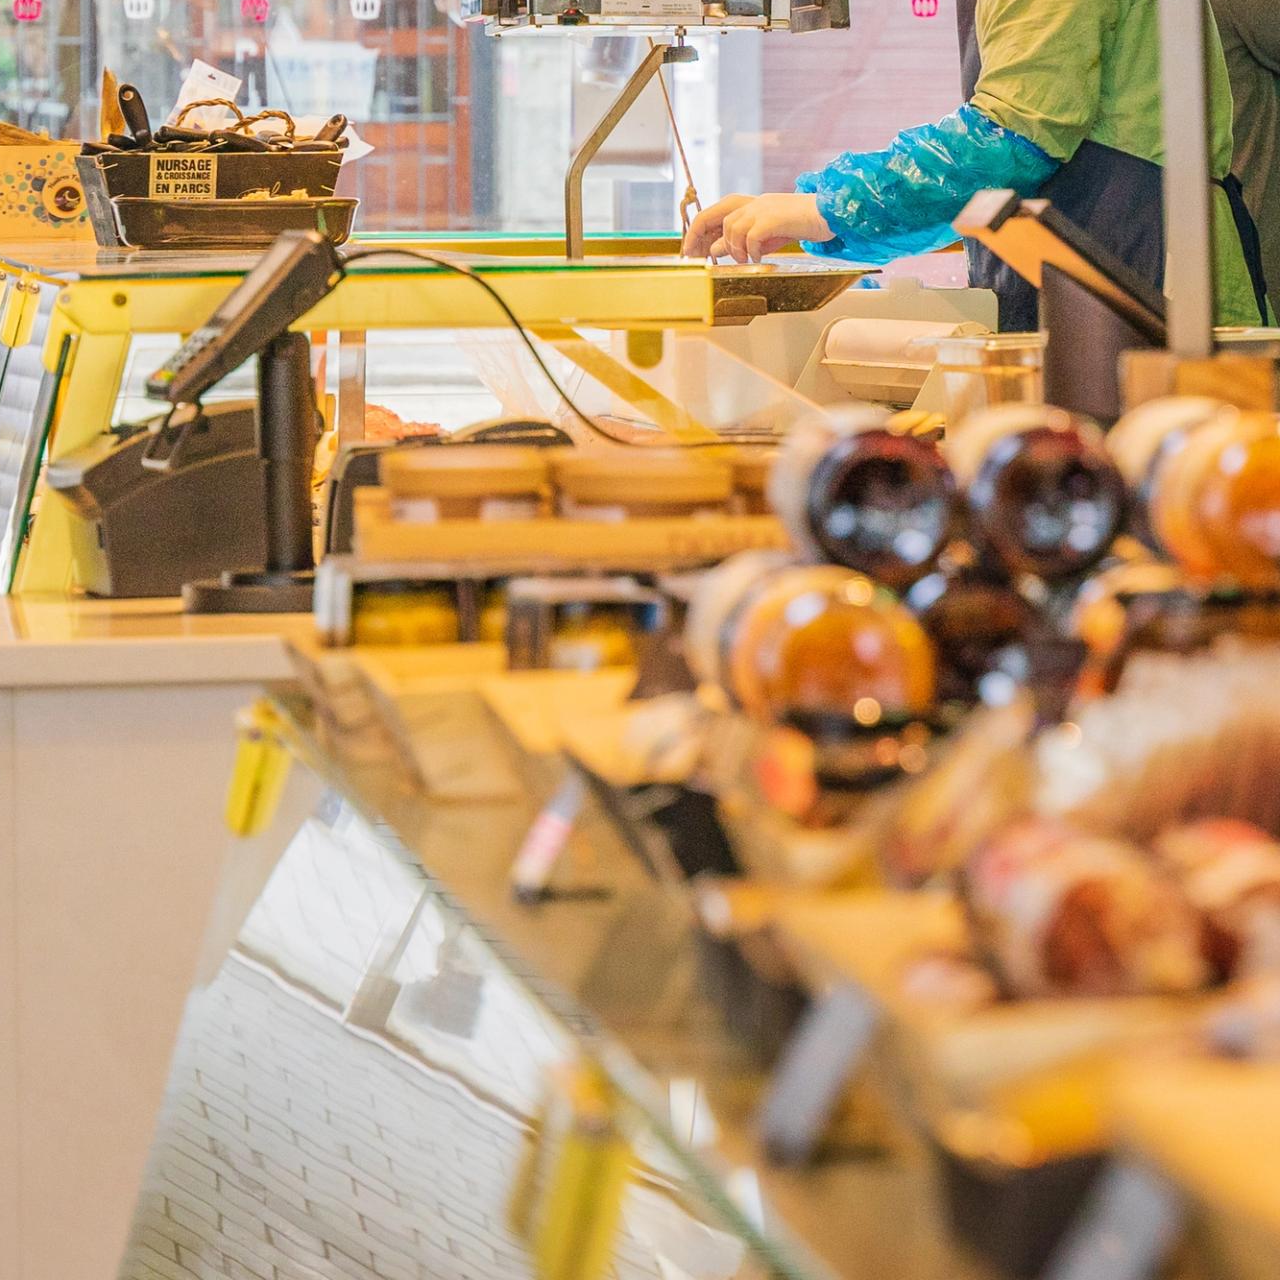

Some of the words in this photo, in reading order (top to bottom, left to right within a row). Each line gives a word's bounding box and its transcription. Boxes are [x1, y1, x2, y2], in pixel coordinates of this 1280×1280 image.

[156, 159, 212, 171] NURSAGE
[156, 172, 163, 180] &
[164, 172, 211, 180] CROISSANCE
[156, 183, 170, 193] EN
[174, 183, 211, 193] PARCS
